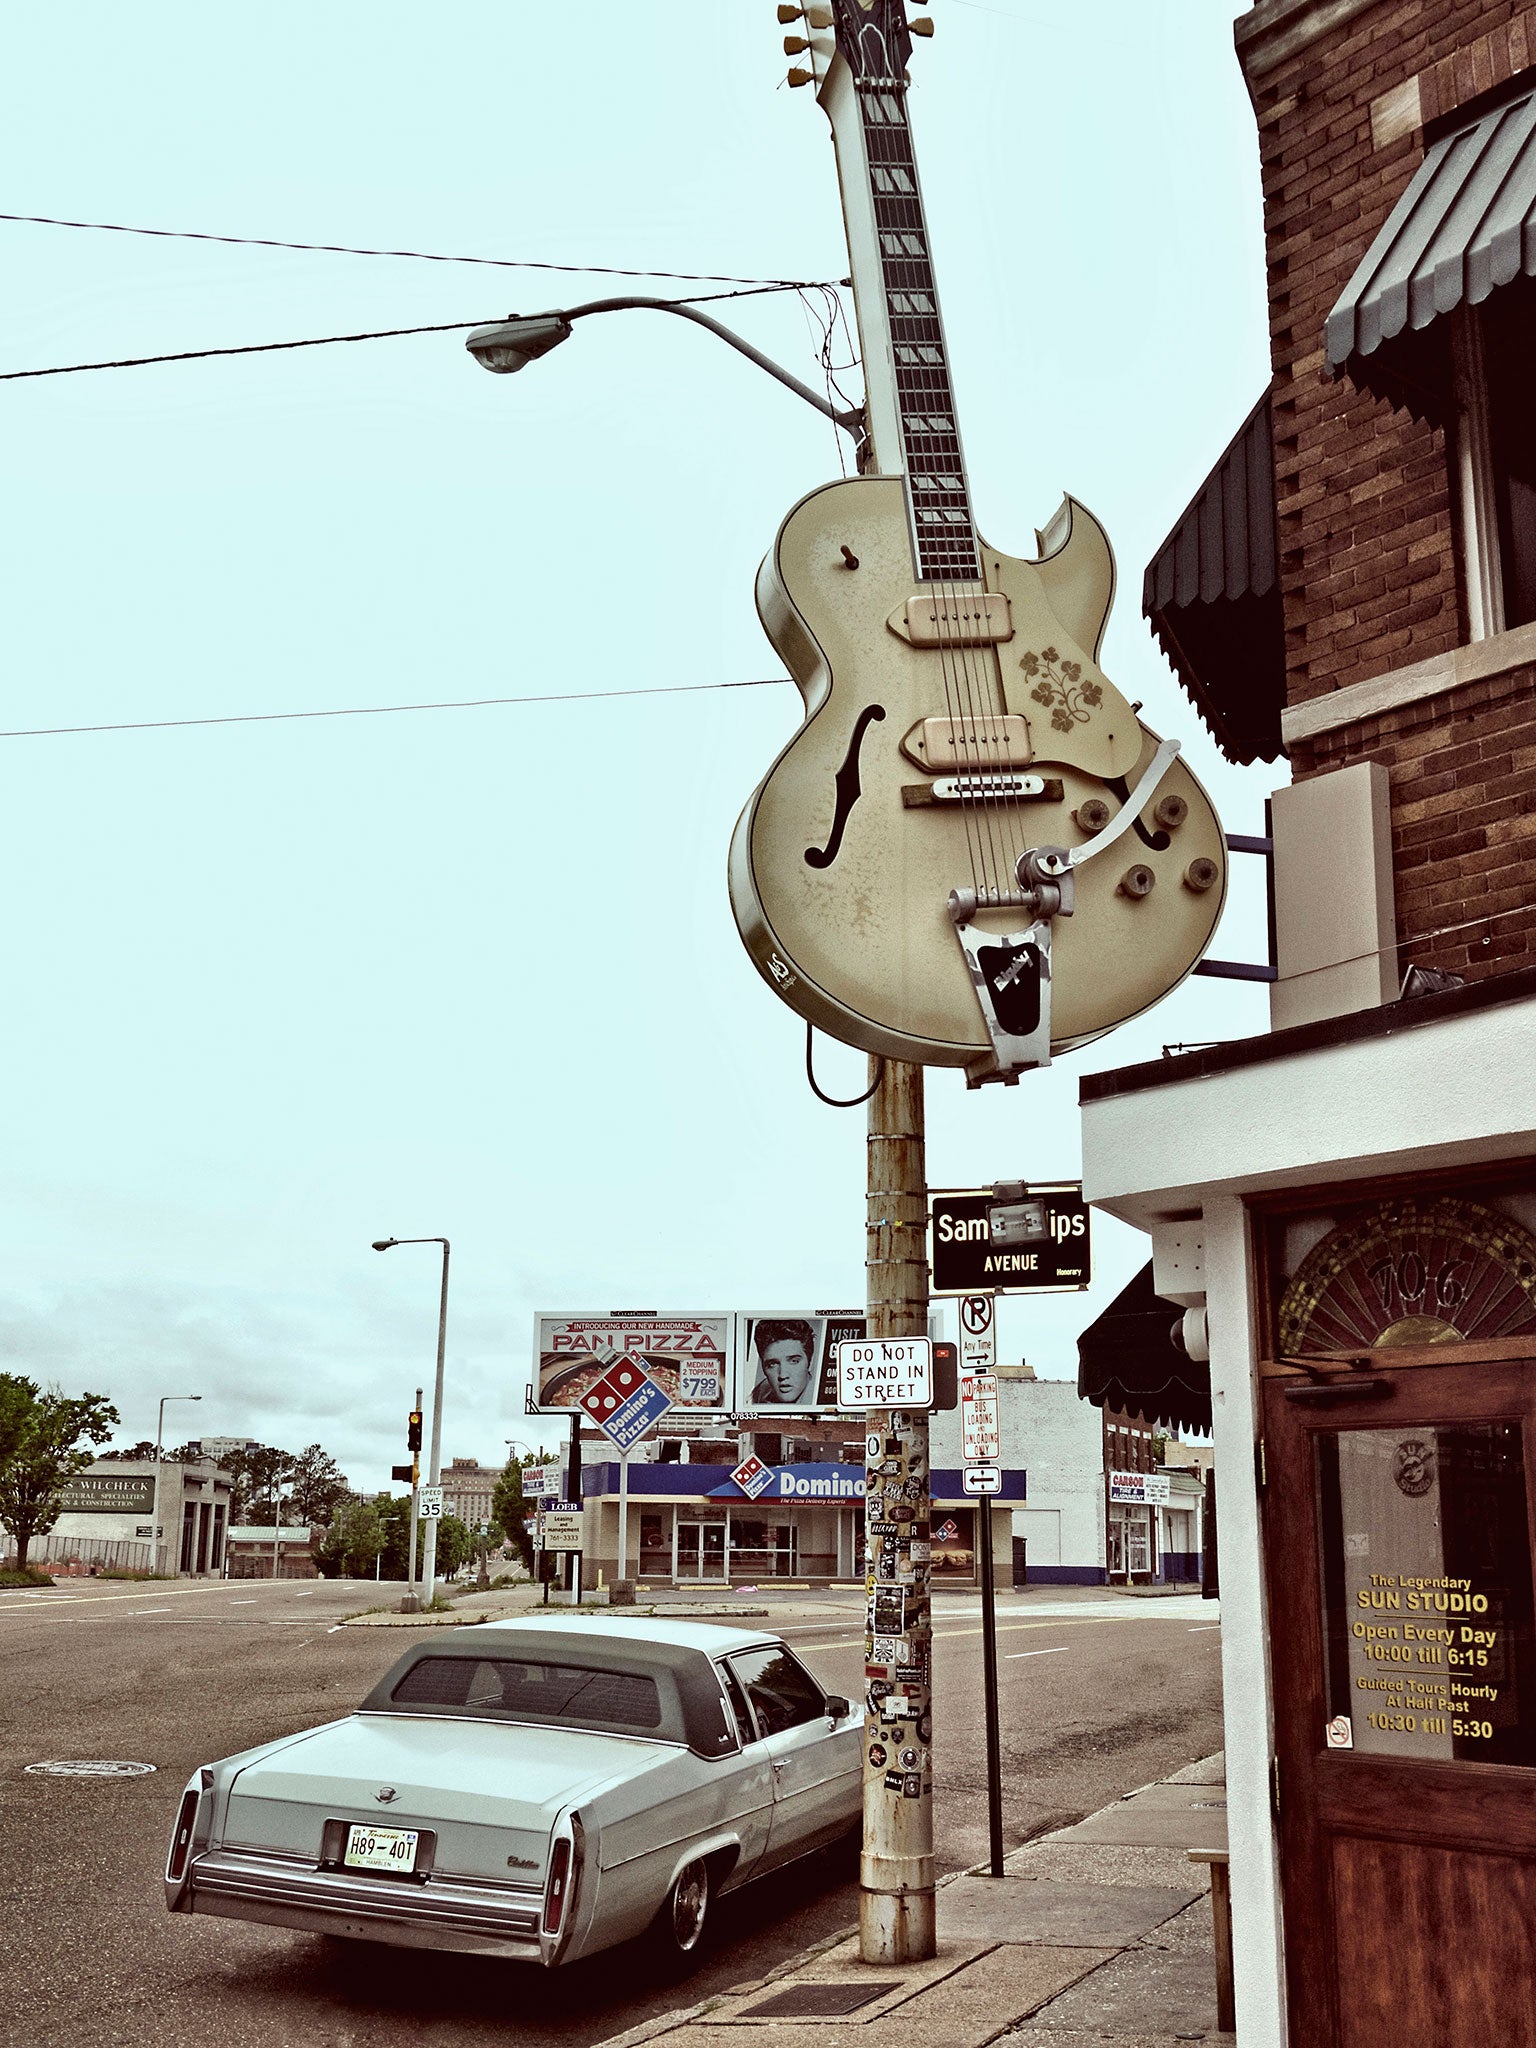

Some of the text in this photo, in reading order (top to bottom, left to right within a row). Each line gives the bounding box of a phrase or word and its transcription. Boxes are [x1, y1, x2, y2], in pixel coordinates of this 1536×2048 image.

[938, 1214, 989, 1242] Sam
[984, 1254, 1039, 1272] AVENUE
[1056, 1268, 1082, 1276] Honorary
[1367, 1251, 1464, 1310] 706
[573, 1322, 695, 1331] INTRODUCING OUR NEW HANDMADE
[831, 1328, 860, 1341] VISIT
[552, 1334, 718, 1351] PAN PIZZA
[964, 1339, 992, 1353] Any Time
[853, 1348, 874, 1362] DO
[883, 1346, 915, 1361] NOT
[682, 1368, 718, 1376] 2 TOPPING
[686, 1361, 714, 1369] MEDIUM
[846, 1365, 924, 1381] STAND IN
[700, 1389, 716, 1397] EACH
[854, 1384, 916, 1399] STREET
[962, 1381, 996, 1398] NO PARKING
[606, 1387, 656, 1434] Domino's
[975, 1401, 987, 1412] BUS
[730, 1412, 759, 1420] 078332
[967, 1413, 993, 1426] LOADING
[616, 1414, 650, 1445] Pizza
[966, 1433, 998, 1445] UNLOADING
[974, 1445, 990, 1456] ONLY
[81, 1481, 148, 1491] WILCHECK
[780, 1472, 867, 1496] Domino
[1113, 1475, 1144, 1487] CARSON
[1398, 1478, 1431, 1493] Studio
[421, 1503, 441, 1516] 35
[551, 1503, 578, 1511] LOEB
[1369, 1573, 1472, 1591] The Legendary
[1357, 1590, 1489, 1613] SUN STUDIO
[1352, 1621, 1497, 1648] Open Every Day
[1364, 1644, 1488, 1667] 10:00 till 6:15
[1356, 1676, 1498, 1701] Guided Tours Hourly
[1386, 1694, 1470, 1713] At Half Past
[1367, 1712, 1493, 1739] 10:30 till 5:30
[367, 1829, 400, 1840] Tennessee
